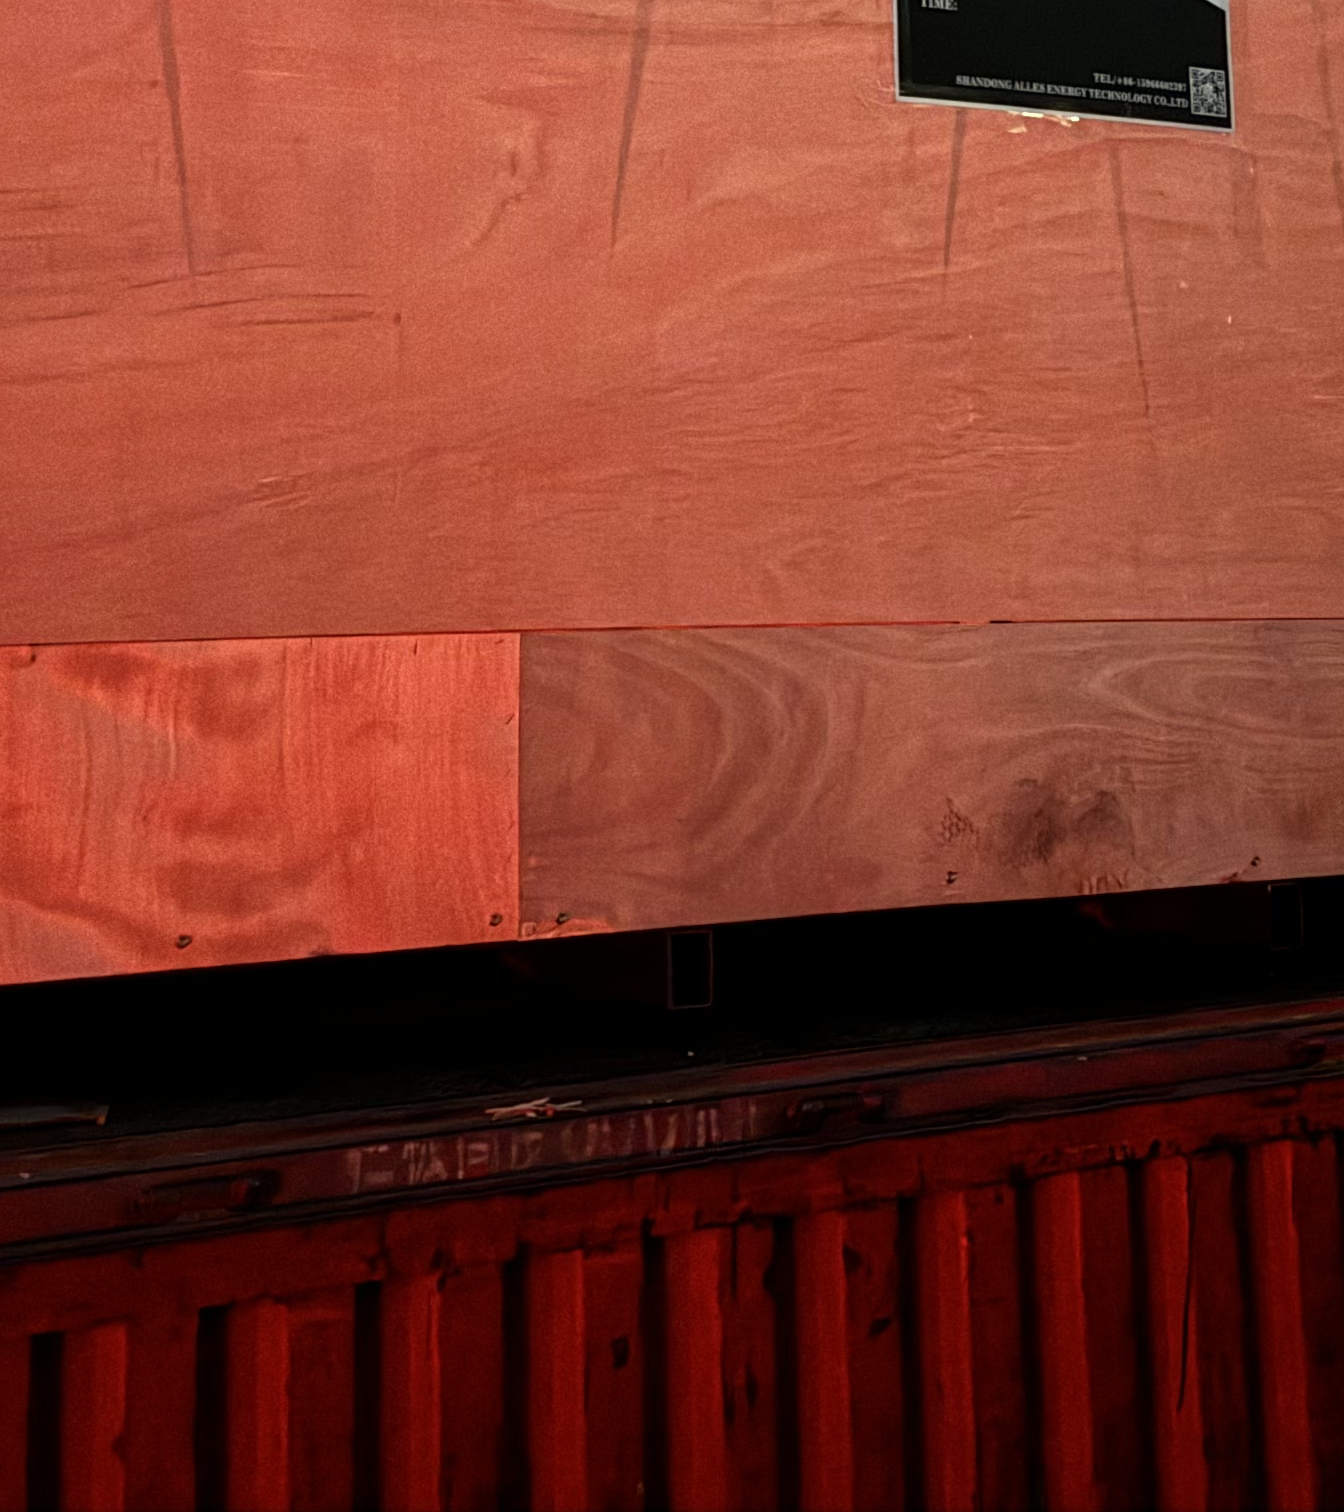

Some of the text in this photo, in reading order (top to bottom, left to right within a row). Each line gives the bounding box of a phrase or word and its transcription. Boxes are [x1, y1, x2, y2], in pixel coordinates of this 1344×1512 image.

[956, 75, 1012, 90] SHANDONG
[1013, 80, 1046, 94] ALLES
[1046, 84, 1088, 98] ENERGY
[1087, 88, 1153, 105] TECHNOLOGY
